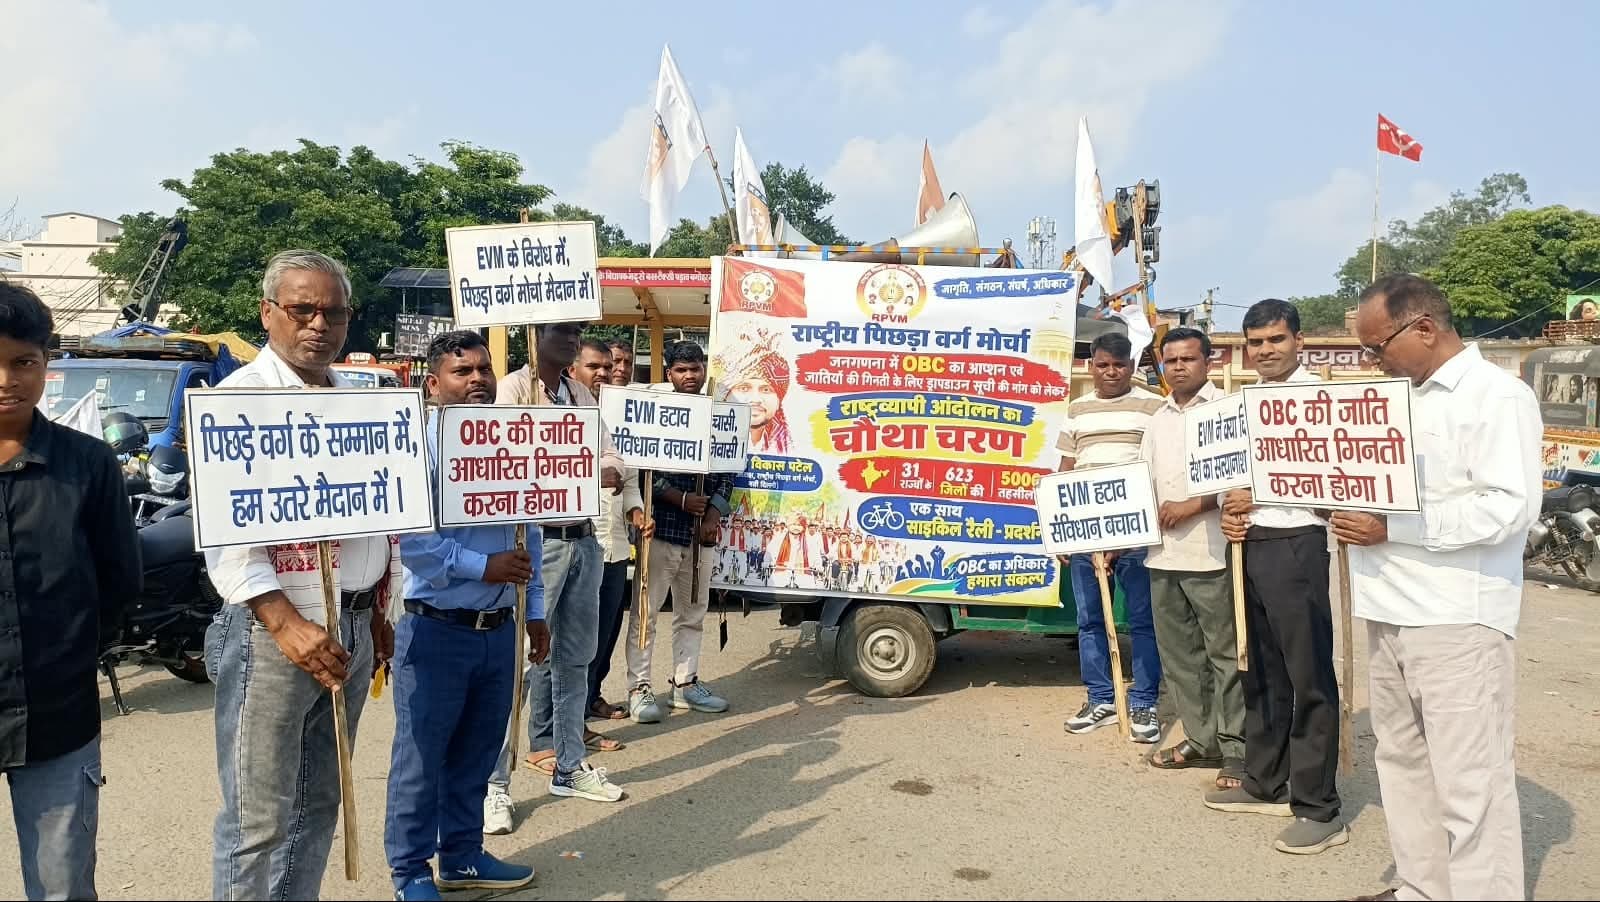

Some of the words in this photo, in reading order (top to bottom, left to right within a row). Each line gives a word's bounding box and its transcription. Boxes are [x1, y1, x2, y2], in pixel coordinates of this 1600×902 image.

[478, 245, 504, 270] EVM
[506, 240, 520, 268] के
[521, 238, 552, 267] विरोध
[554, 237, 570, 267] में,
[460, 277, 494, 314] पिछड़ा
[495, 275, 514, 305] वर्ग
[516, 272, 542, 304] मोर्चा
[544, 275, 577, 302] मैदान
[942, 281, 972, 296] जागृति,
[976, 281, 1006, 292] संगठन,
[1008, 278, 1030, 292] संघर्ष,
[1033, 278, 1068, 291] अधिकार
[742, 301, 773, 312] RPVM
[872, 314, 908, 323] RPVM
[791, 320, 859, 348] राष्ट्रीय
[863, 322, 930, 351] पिछड़ा
[935, 326, 972, 348] वर्ग
[976, 328, 1031, 353] मोर्चा
[829, 356, 886, 370] जनगणना
[889, 354, 900, 370] में
[902, 355, 945, 374] OBC
[949, 361, 965, 374] का
[968, 362, 1006, 376] आप्शन
[1010, 364, 1024, 377] एवं
[846, 370, 859, 386] की
[862, 371, 890, 386] गिनती
[892, 373, 902, 386] के
[904, 374, 924, 390] लिए
[974, 378, 996, 394] सूची
[998, 380, 1010, 392] की
[1012, 382, 1028, 395] मांग
[1030, 381, 1042, 396] को
[1044, 382, 1066, 397] लेकर
[624, 399, 655, 424] EVM
[660, 406, 691, 428] हटाव
[712, 408, 738, 432] च्चासी,
[840, 394, 926, 419] राष्ट्रव्यापी
[930, 396, 1000, 420] आंदोलन
[1002, 407, 1022, 422] का
[1260, 399, 1297, 426] OBC
[1303, 391, 1332, 426] की
[1338, 388, 1389, 424] जाति
[460, 419, 500, 446] OBC
[506, 412, 534, 445] की
[539, 412, 584, 445] जाति
[830, 417, 928, 453] चौथा
[935, 425, 1026, 458] चरण
[1198, 419, 1214, 447] EVM
[1216, 412, 1222, 442] ने
[1224, 416, 1237, 440] क्या
[1238, 403, 1247, 438] दि
[200, 413, 255, 474] पिछड़े
[260, 411, 294, 460] वर्ग
[298, 412, 320, 458] के
[324, 420, 388, 458] सम्मान
[394, 407, 418, 458] में,
[1255, 429, 1328, 463] आधारित
[1333, 426, 1404, 465] गिनती
[448, 448, 528, 482] आधारित
[534, 448, 594, 480] गिनती
[751, 456, 786, 471] विकास
[788, 459, 813, 472] पटेल
[902, 462, 920, 478] 31
[945, 467, 974, 482] 623
[1190, 452, 1202, 483] देश
[1202, 458, 1213, 480] का
[230, 487, 264, 528] हम
[268, 476, 310, 523] उतरे
[313, 473, 368, 518] मैदान
[372, 468, 389, 515] में
[900, 478, 924, 489] राज्यों
[924, 480, 932, 490] के
[940, 481, 968, 496] जिलों
[970, 484, 984, 496] की
[998, 486, 1036, 500] तहसील
[1058, 481, 1090, 508] EVM
[1094, 476, 1127, 506] हटाव
[1268, 472, 1322, 499] करना
[1329, 466, 1376, 503] होगा
[462, 489, 518, 518] करना
[524, 483, 568, 516] होगा
[910, 502, 932, 516] एक
[934, 504, 963, 518] साथ
[906, 516, 962, 538] साइकिल
[965, 516, 994, 539] रैली
[1050, 511, 1102, 544] संविधान
[957, 559, 986, 574] OBC
[988, 560, 1002, 571] का
[1004, 555, 1048, 572] अधिकार
[966, 574, 1002, 590] हमारा
[1004, 571, 1046, 586] संकल्प
